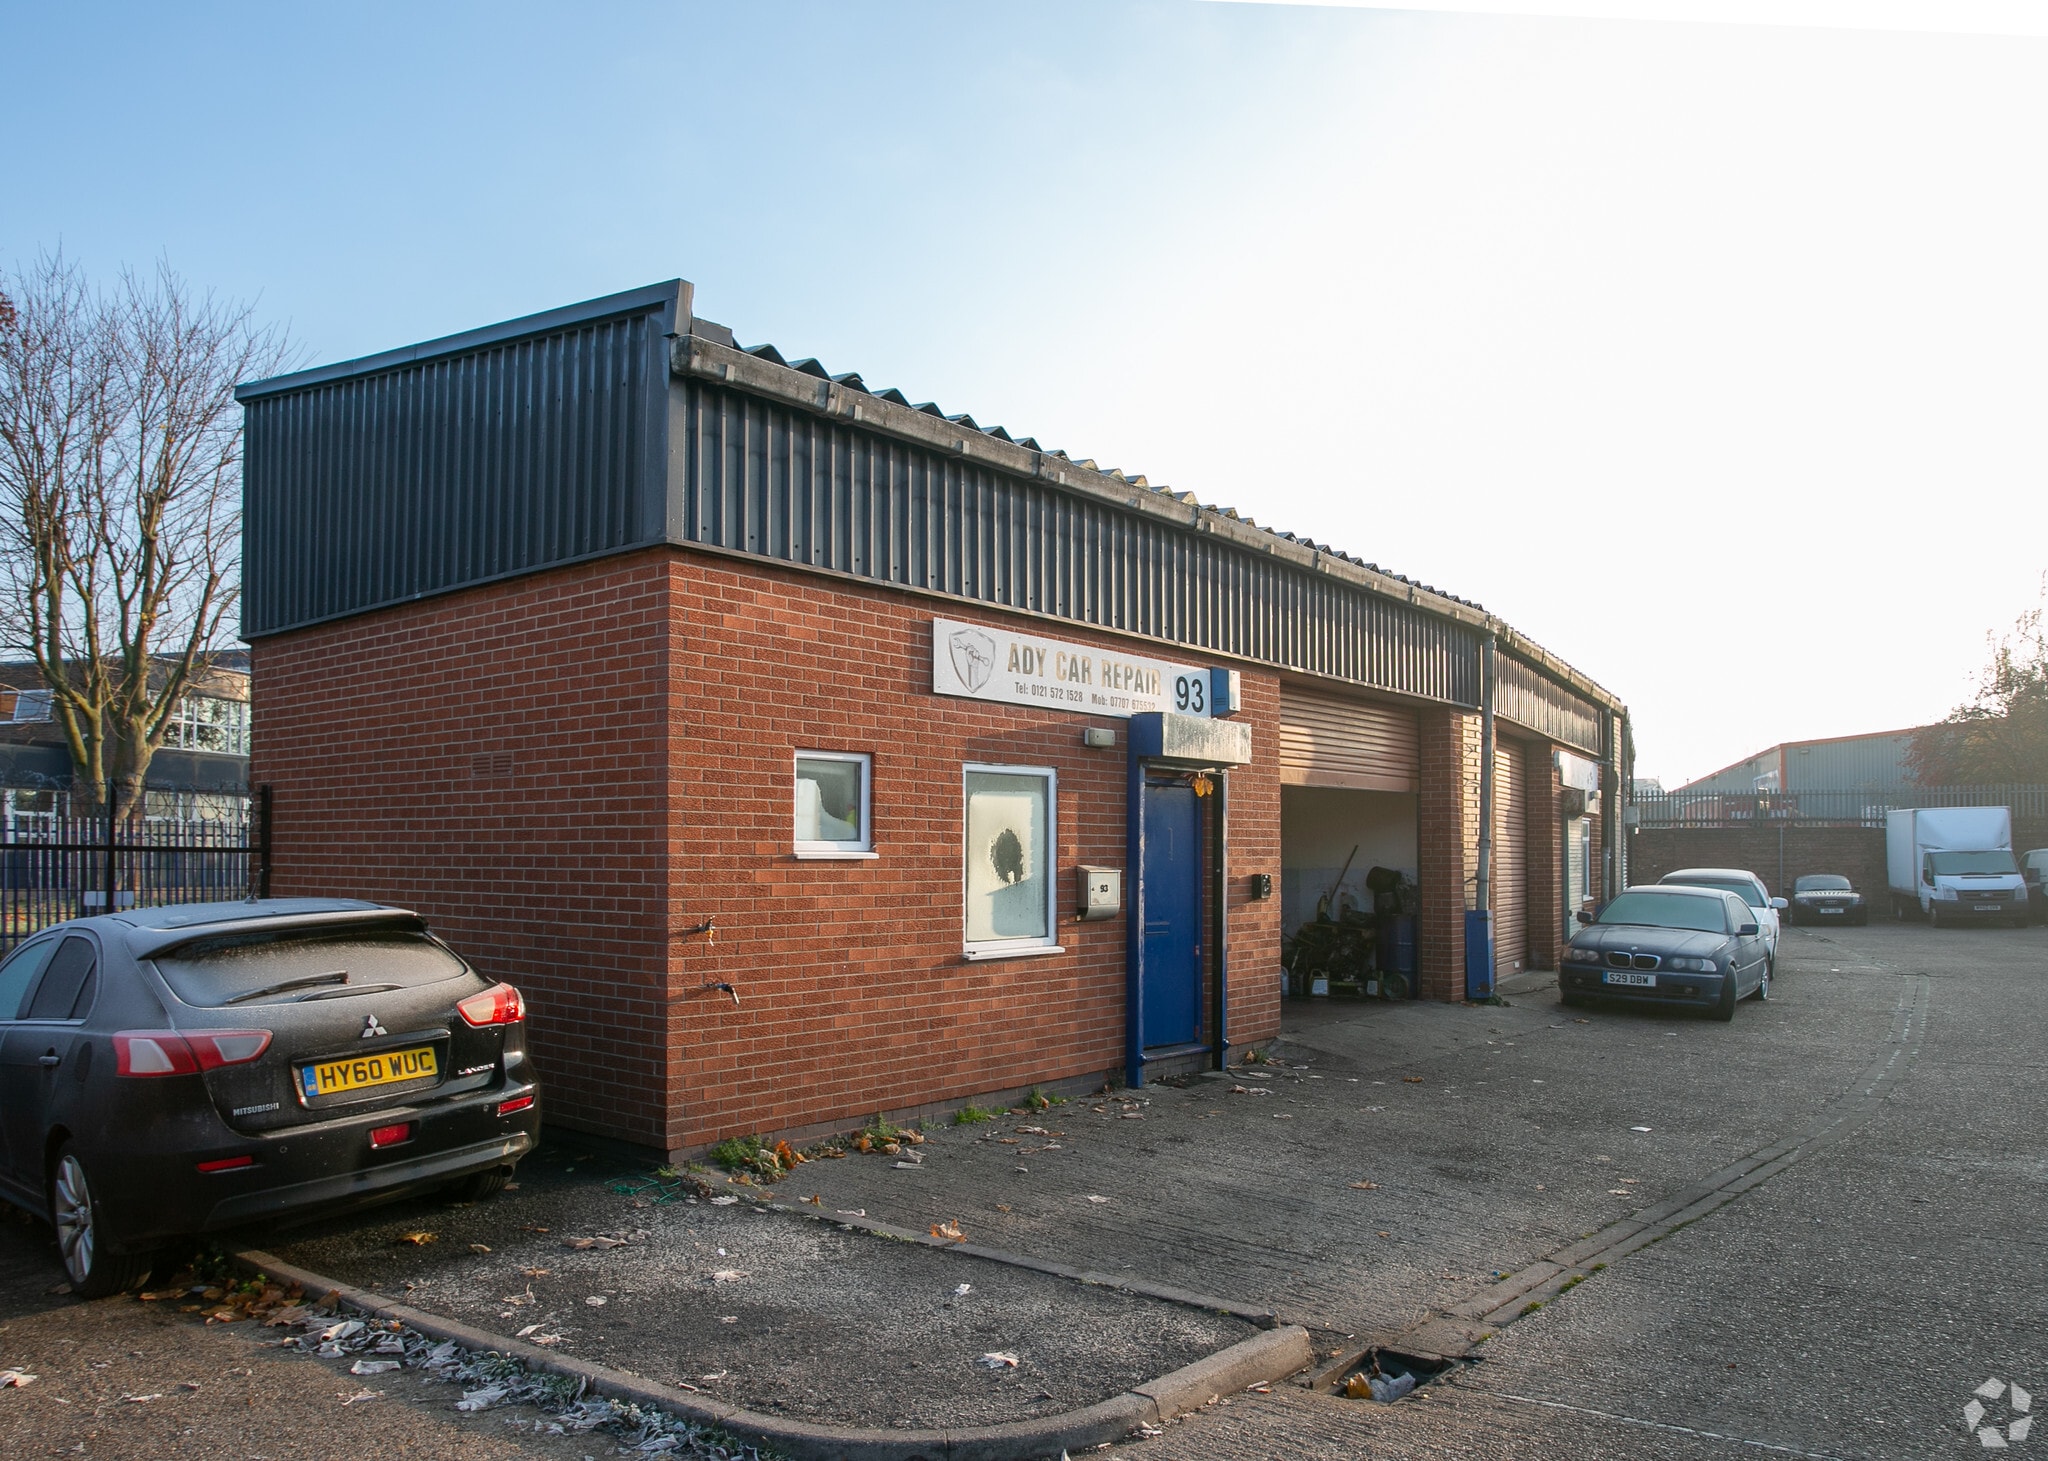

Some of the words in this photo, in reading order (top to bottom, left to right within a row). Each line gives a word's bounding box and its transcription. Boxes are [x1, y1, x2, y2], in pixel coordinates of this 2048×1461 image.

[1007, 642, 1047, 677] ADY
[1055, 650, 1092, 685] CAR
[1101, 658, 1161, 696] REPAIR
[1015, 682, 1029, 695] Tel:
[1031, 684, 1048, 698] 0121
[1049, 687, 1064, 700] 572
[1066, 690, 1083, 703] 1528
[1091, 693, 1108, 706] Mob:
[1110, 695, 1129, 711] 07707
[1175, 676, 1204, 713] 93
[1100, 884, 1109, 893] 93
[1609, 973, 1628, 983] S29
[1630, 975, 1649, 984] DBW
[320, 1059, 383, 1088] HY60
[388, 1051, 433, 1077] WUC
[232, 1102, 280, 1117] MITSUBISHI
